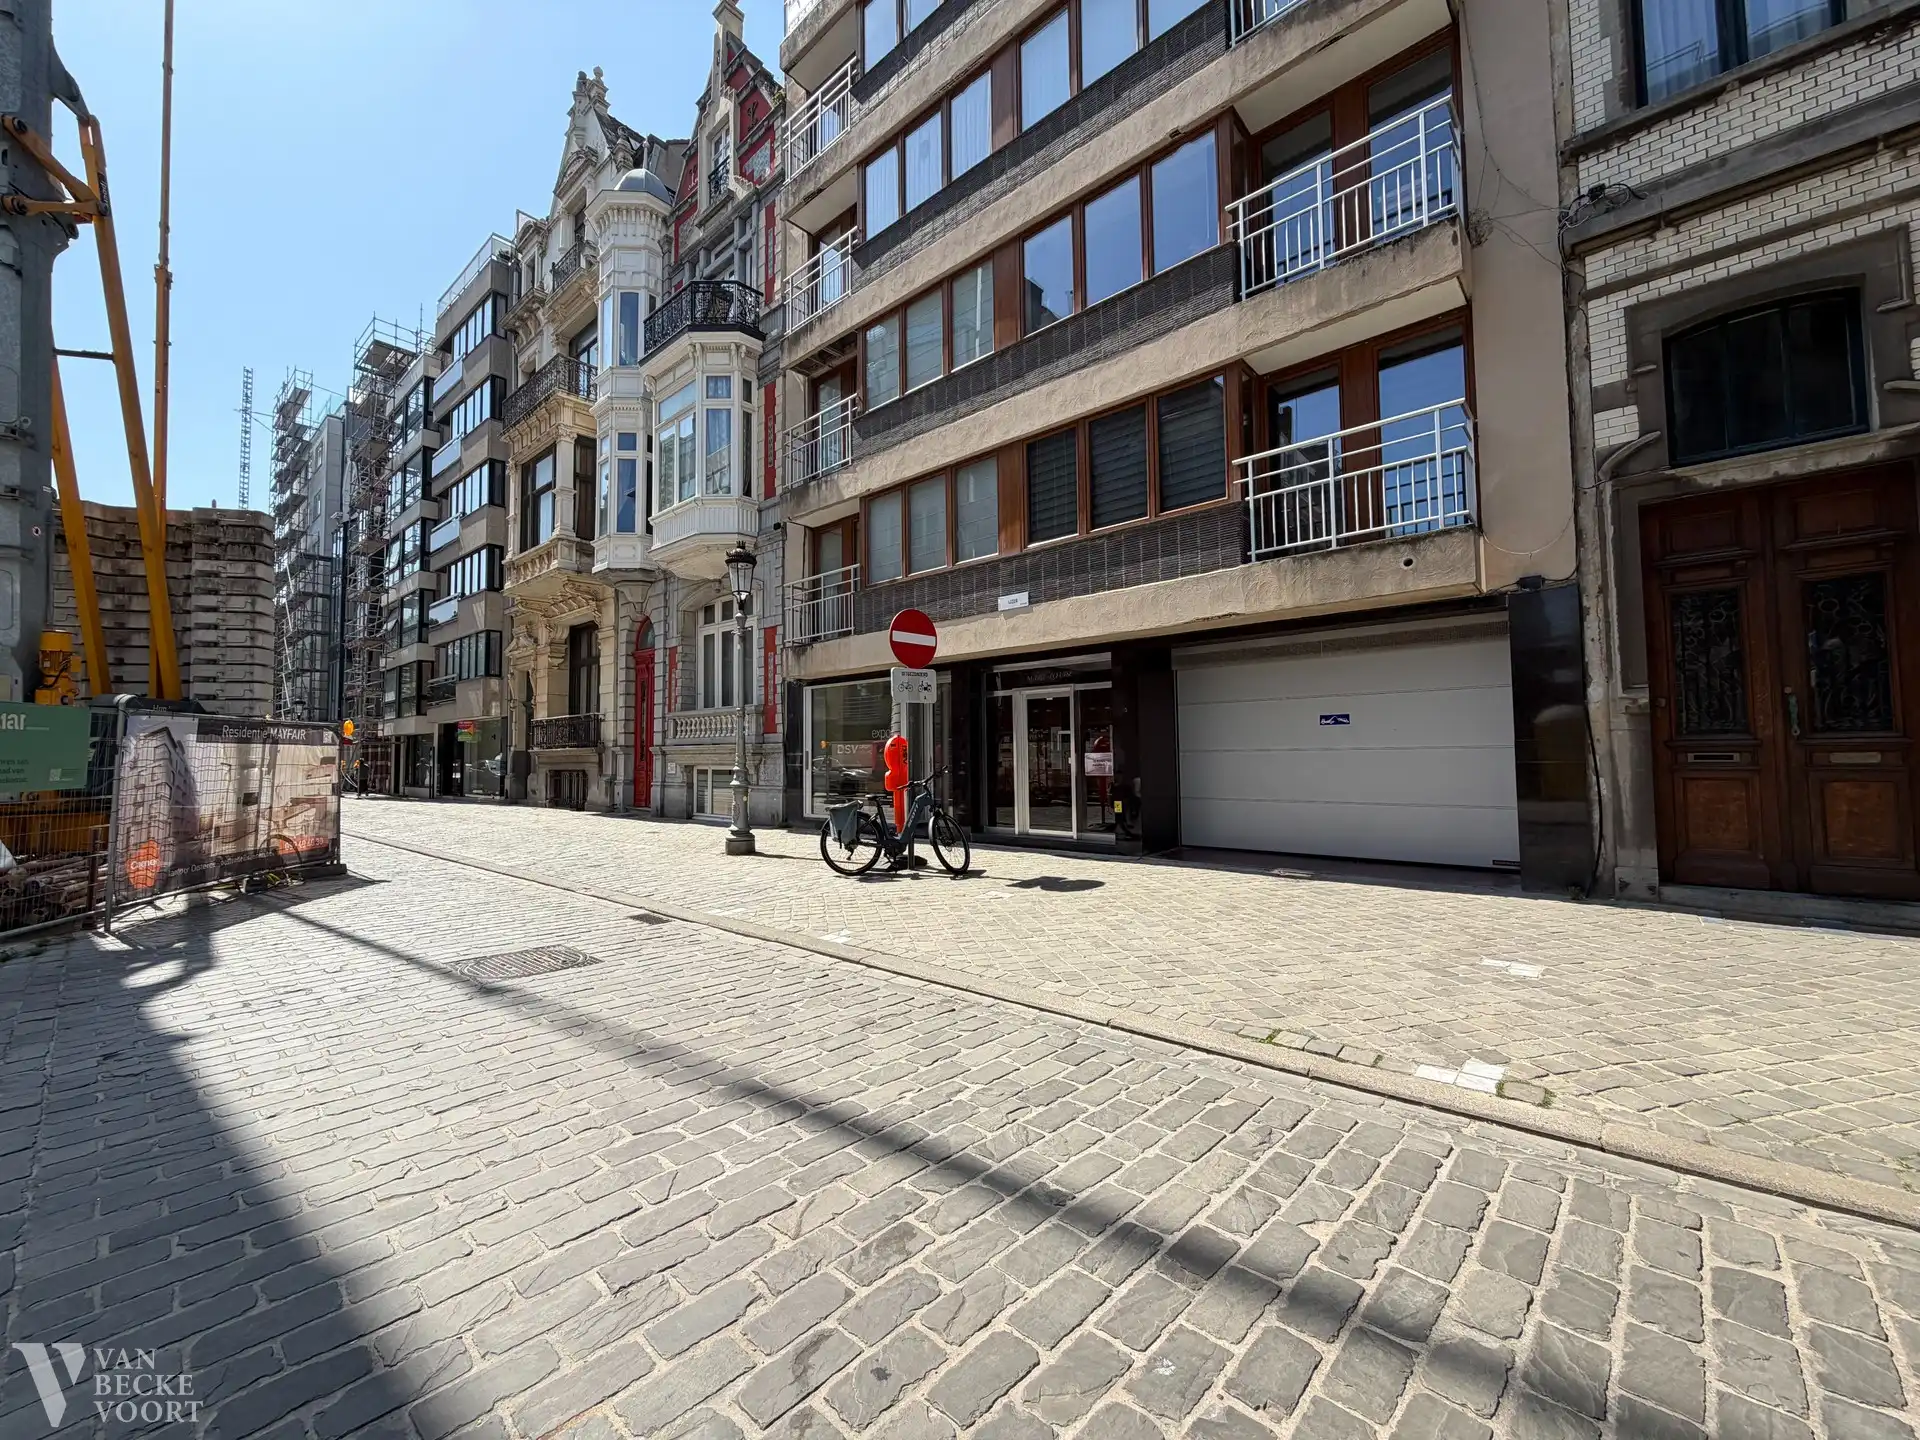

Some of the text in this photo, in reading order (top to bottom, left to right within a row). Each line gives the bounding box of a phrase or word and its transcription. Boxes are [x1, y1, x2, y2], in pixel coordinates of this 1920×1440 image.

[222, 725, 306, 741] Residentie MAYFAIR
[837, 744, 859, 754] DSV
